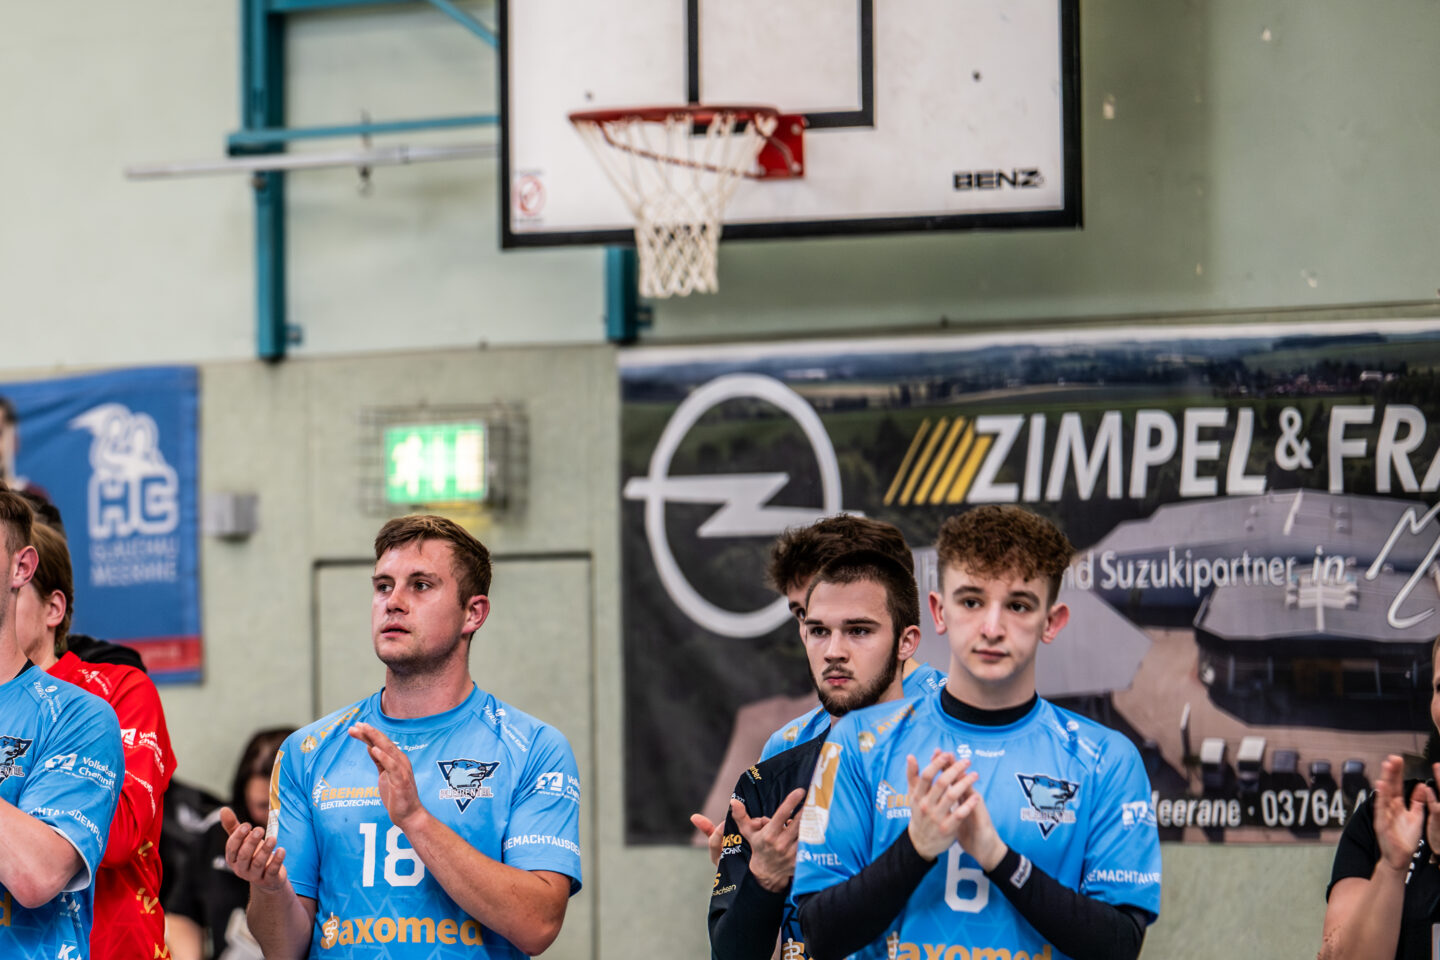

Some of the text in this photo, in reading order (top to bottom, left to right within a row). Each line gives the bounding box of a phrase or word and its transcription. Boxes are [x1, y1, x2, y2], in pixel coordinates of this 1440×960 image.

[953, 167, 1040, 191] BENZ
[966, 407, 1267, 502] ZIMPEL
[1274, 406, 1315, 471] &
[1061, 545, 1345, 597] nd Suzukipartner in
[1261, 789, 1346, 827] 03764
[359, 822, 425, 888] 18
[944, 843, 989, 914] 6
